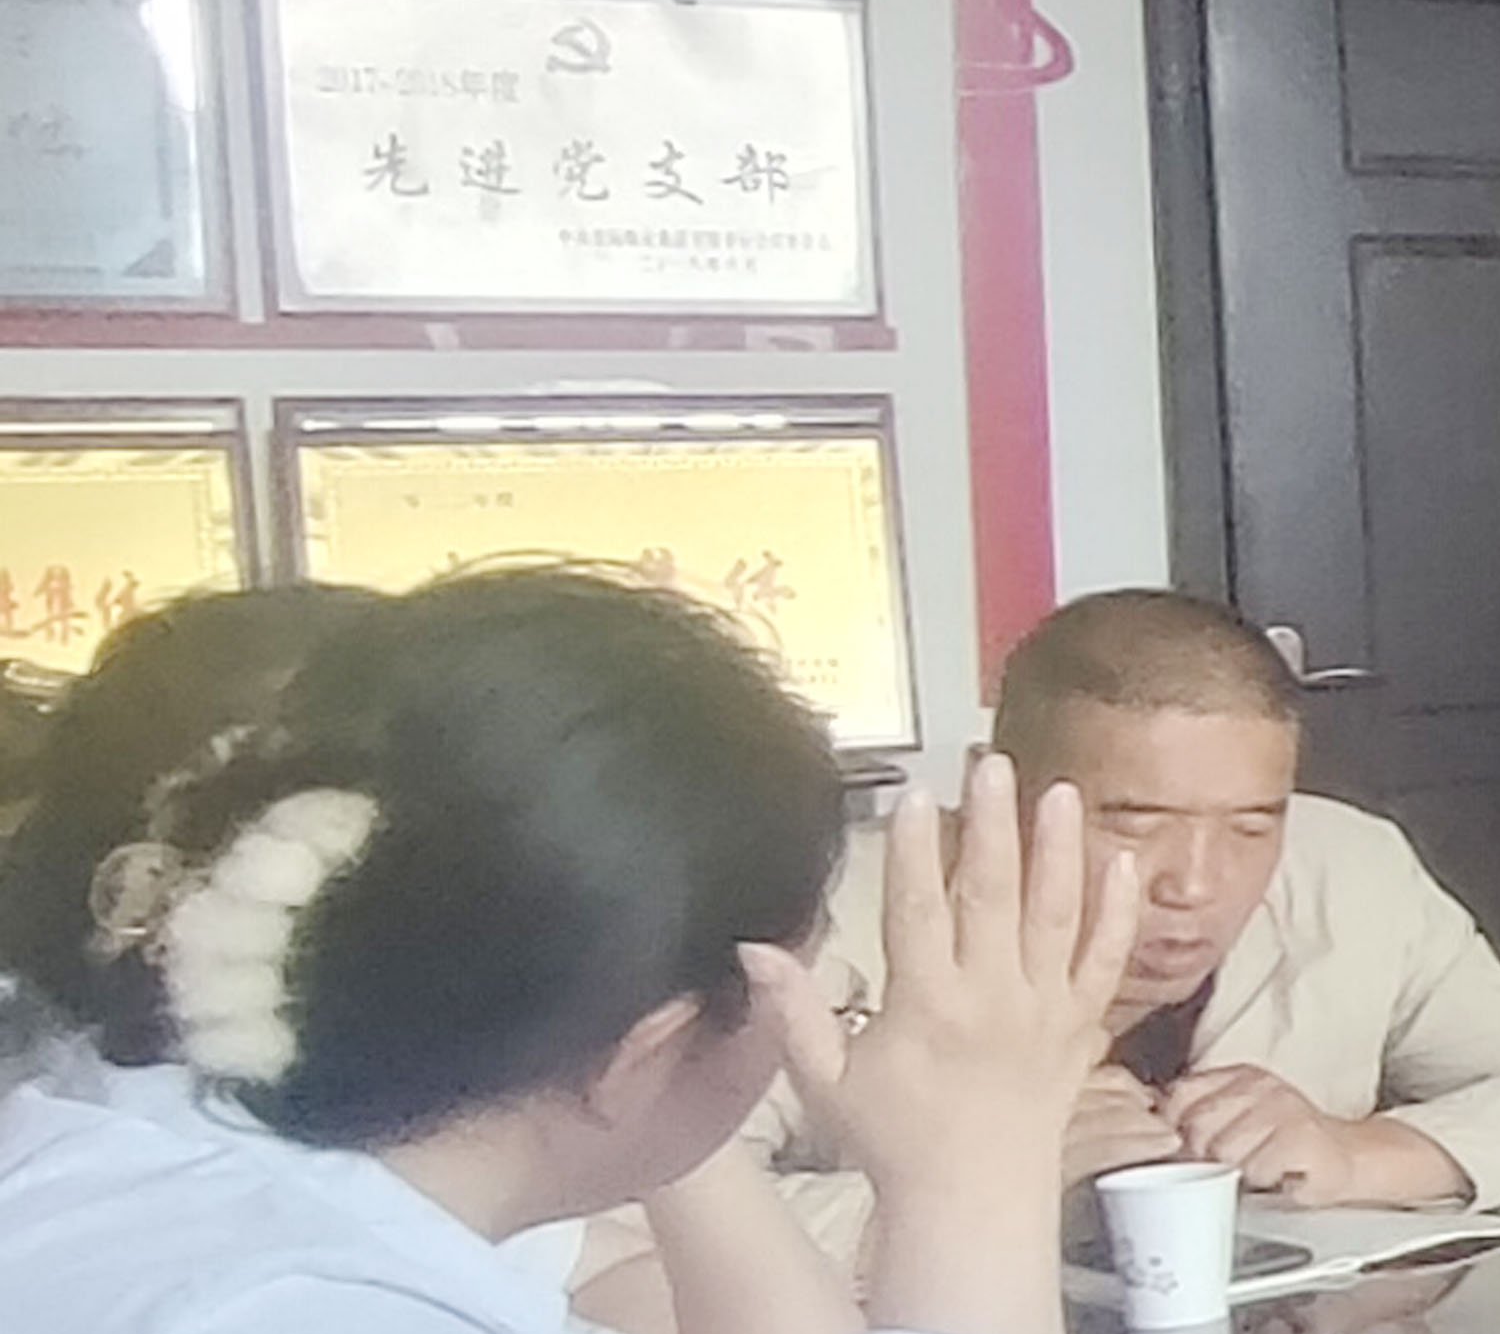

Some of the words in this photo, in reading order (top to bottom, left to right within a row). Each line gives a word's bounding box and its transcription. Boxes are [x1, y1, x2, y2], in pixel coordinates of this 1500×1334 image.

[363, 134, 792, 204] 先进党支部
